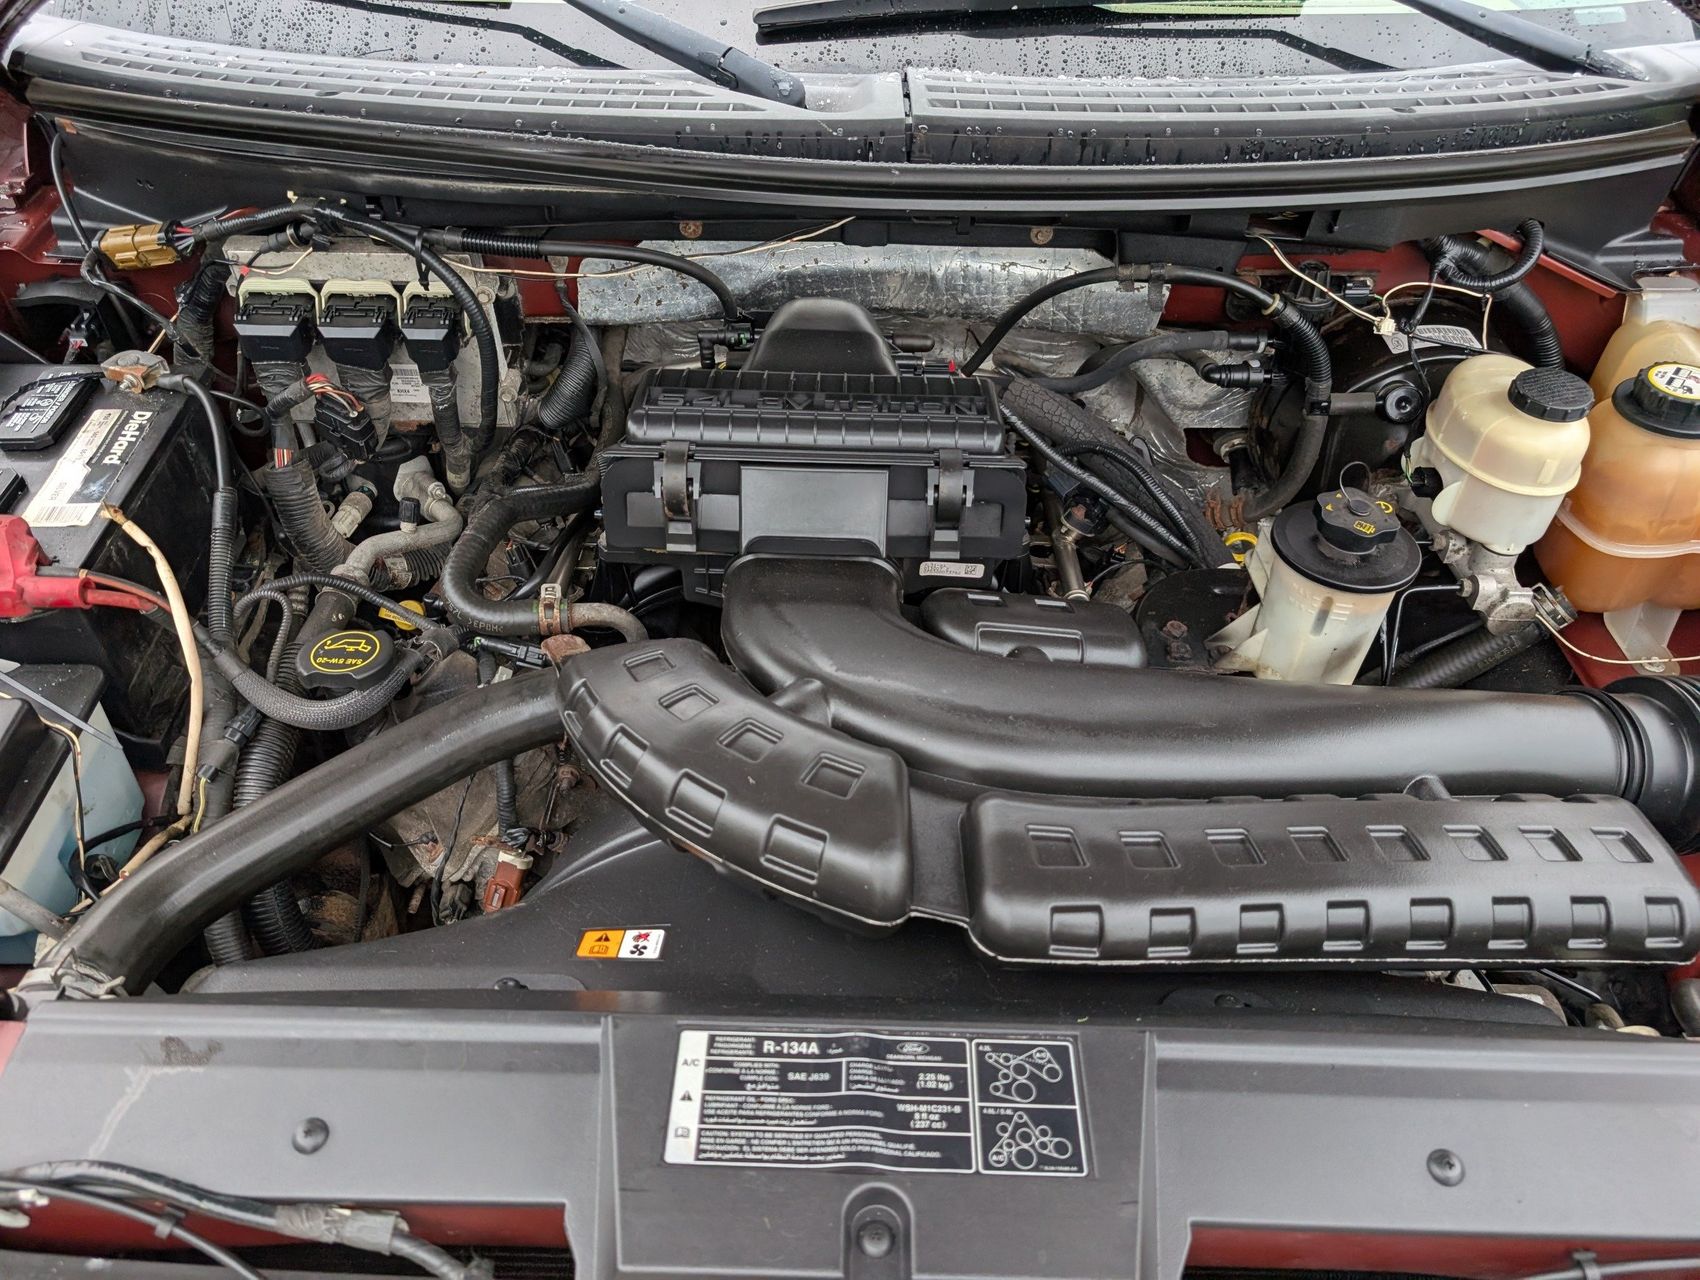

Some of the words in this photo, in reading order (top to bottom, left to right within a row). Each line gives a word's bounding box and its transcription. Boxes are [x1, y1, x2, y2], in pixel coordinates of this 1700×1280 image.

[103, 411, 153, 465] DieHard
[763, 1040, 820, 1055] R-134A
[682, 1058, 700, 1067] A/C
[787, 1072, 807, 1081] SAE
